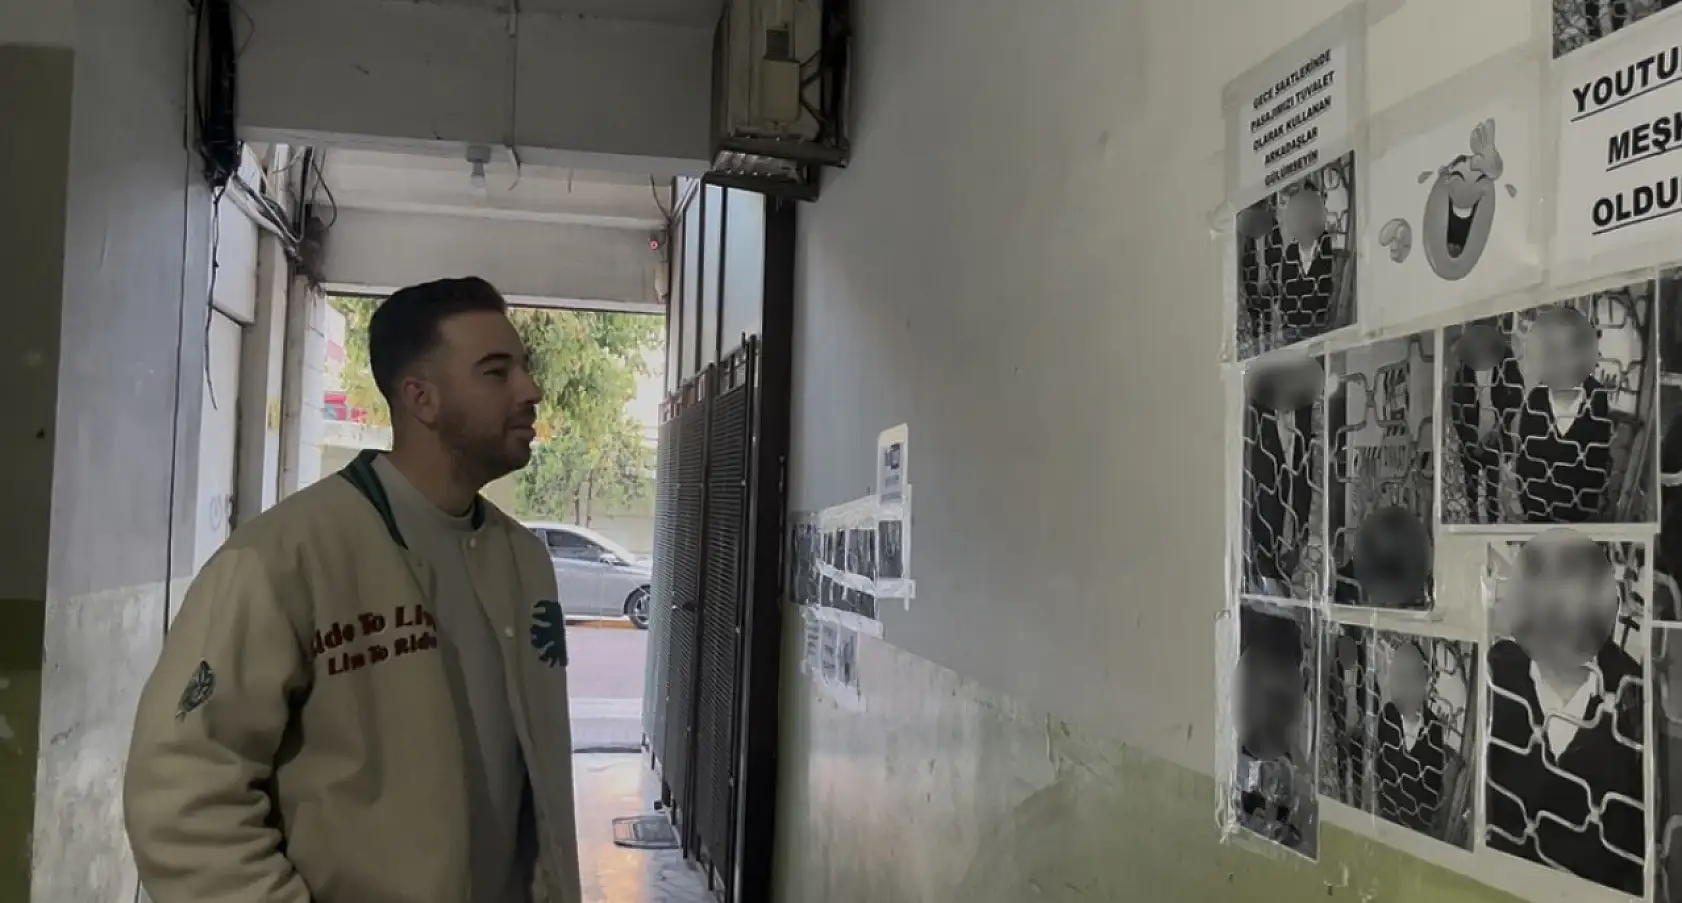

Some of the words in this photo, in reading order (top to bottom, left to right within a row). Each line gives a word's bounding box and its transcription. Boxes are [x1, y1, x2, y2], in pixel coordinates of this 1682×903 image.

[1295, 70, 1334, 103] TUVALET
[1573, 45, 1682, 113] YOUTU
[1253, 124, 1283, 151] OLARAK
[1286, 95, 1332, 129] KULLANAN
[1592, 176, 1682, 227] OLDU
[311, 622, 355, 656] ide
[358, 612, 386, 636] To
[367, 645, 389, 663] To
